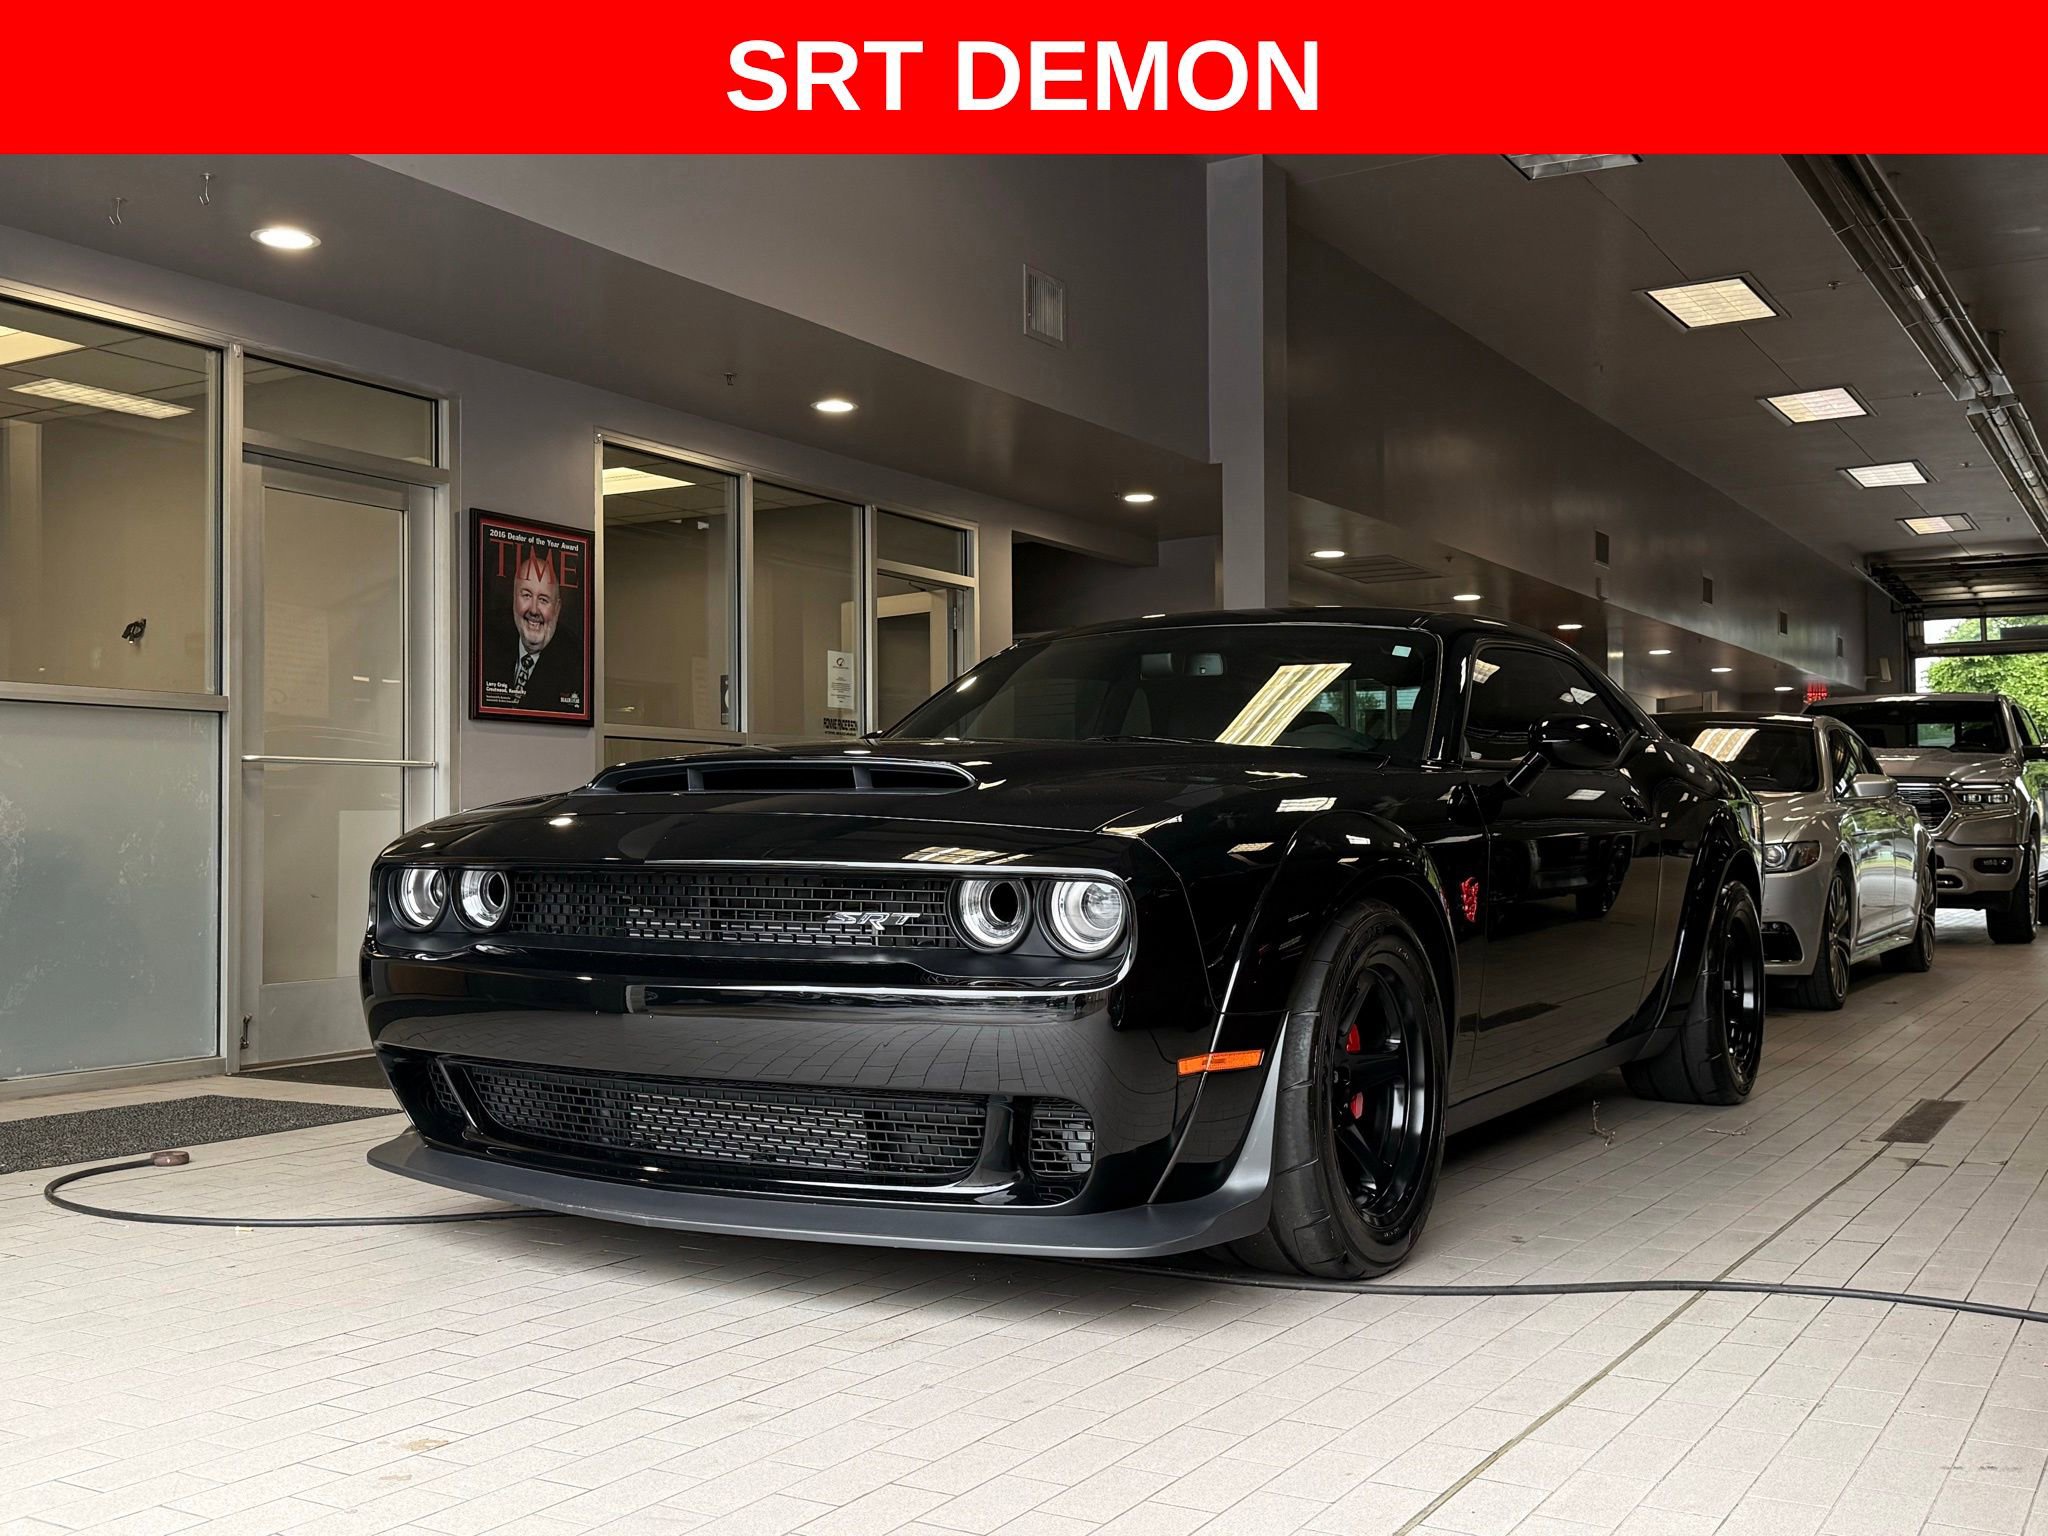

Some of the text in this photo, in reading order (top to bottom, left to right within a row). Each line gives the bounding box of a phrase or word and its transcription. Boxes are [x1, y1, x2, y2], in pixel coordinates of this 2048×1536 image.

[489, 529, 579, 552] 2016 Dealer of the Year Award
[489, 537, 579, 589] TIME
[826, 911, 922, 931] SRT
